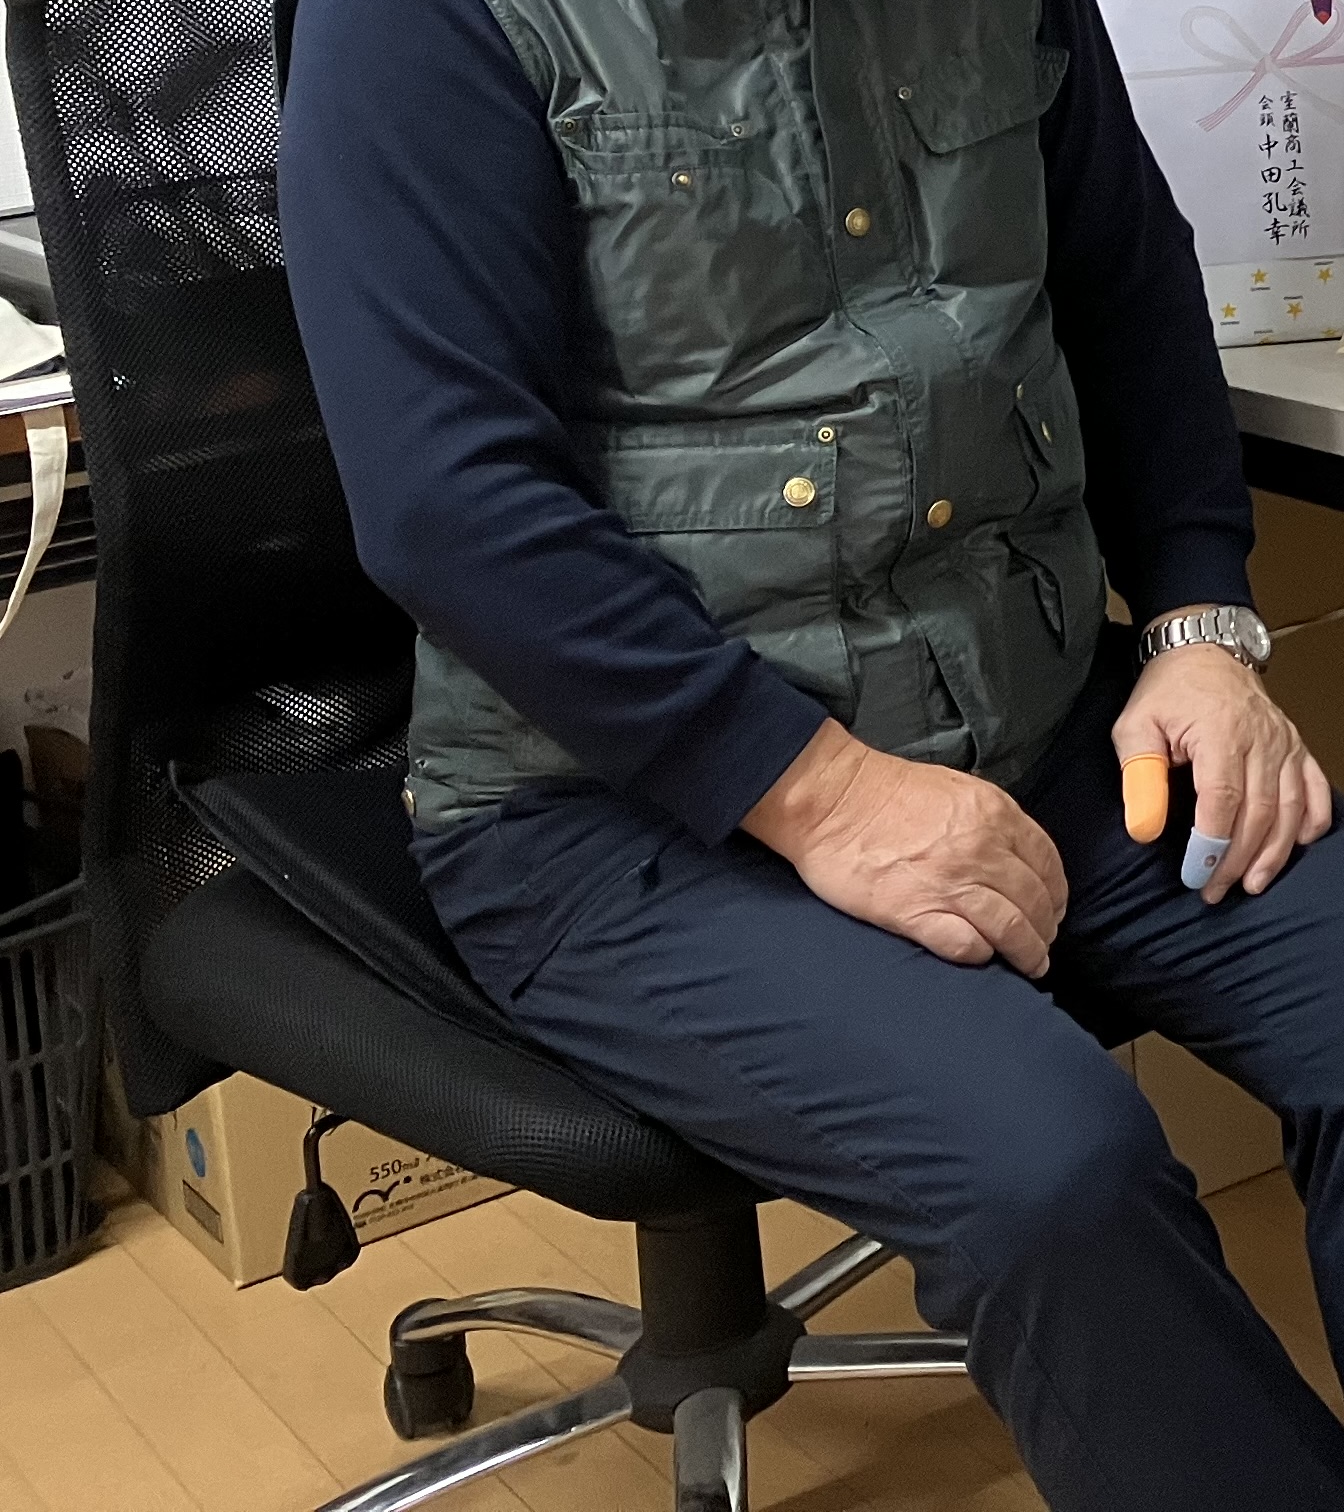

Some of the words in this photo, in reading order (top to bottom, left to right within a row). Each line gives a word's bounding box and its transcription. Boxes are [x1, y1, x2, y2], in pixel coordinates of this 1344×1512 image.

[1280, 90, 1311, 240] 室蘭商工会議所
